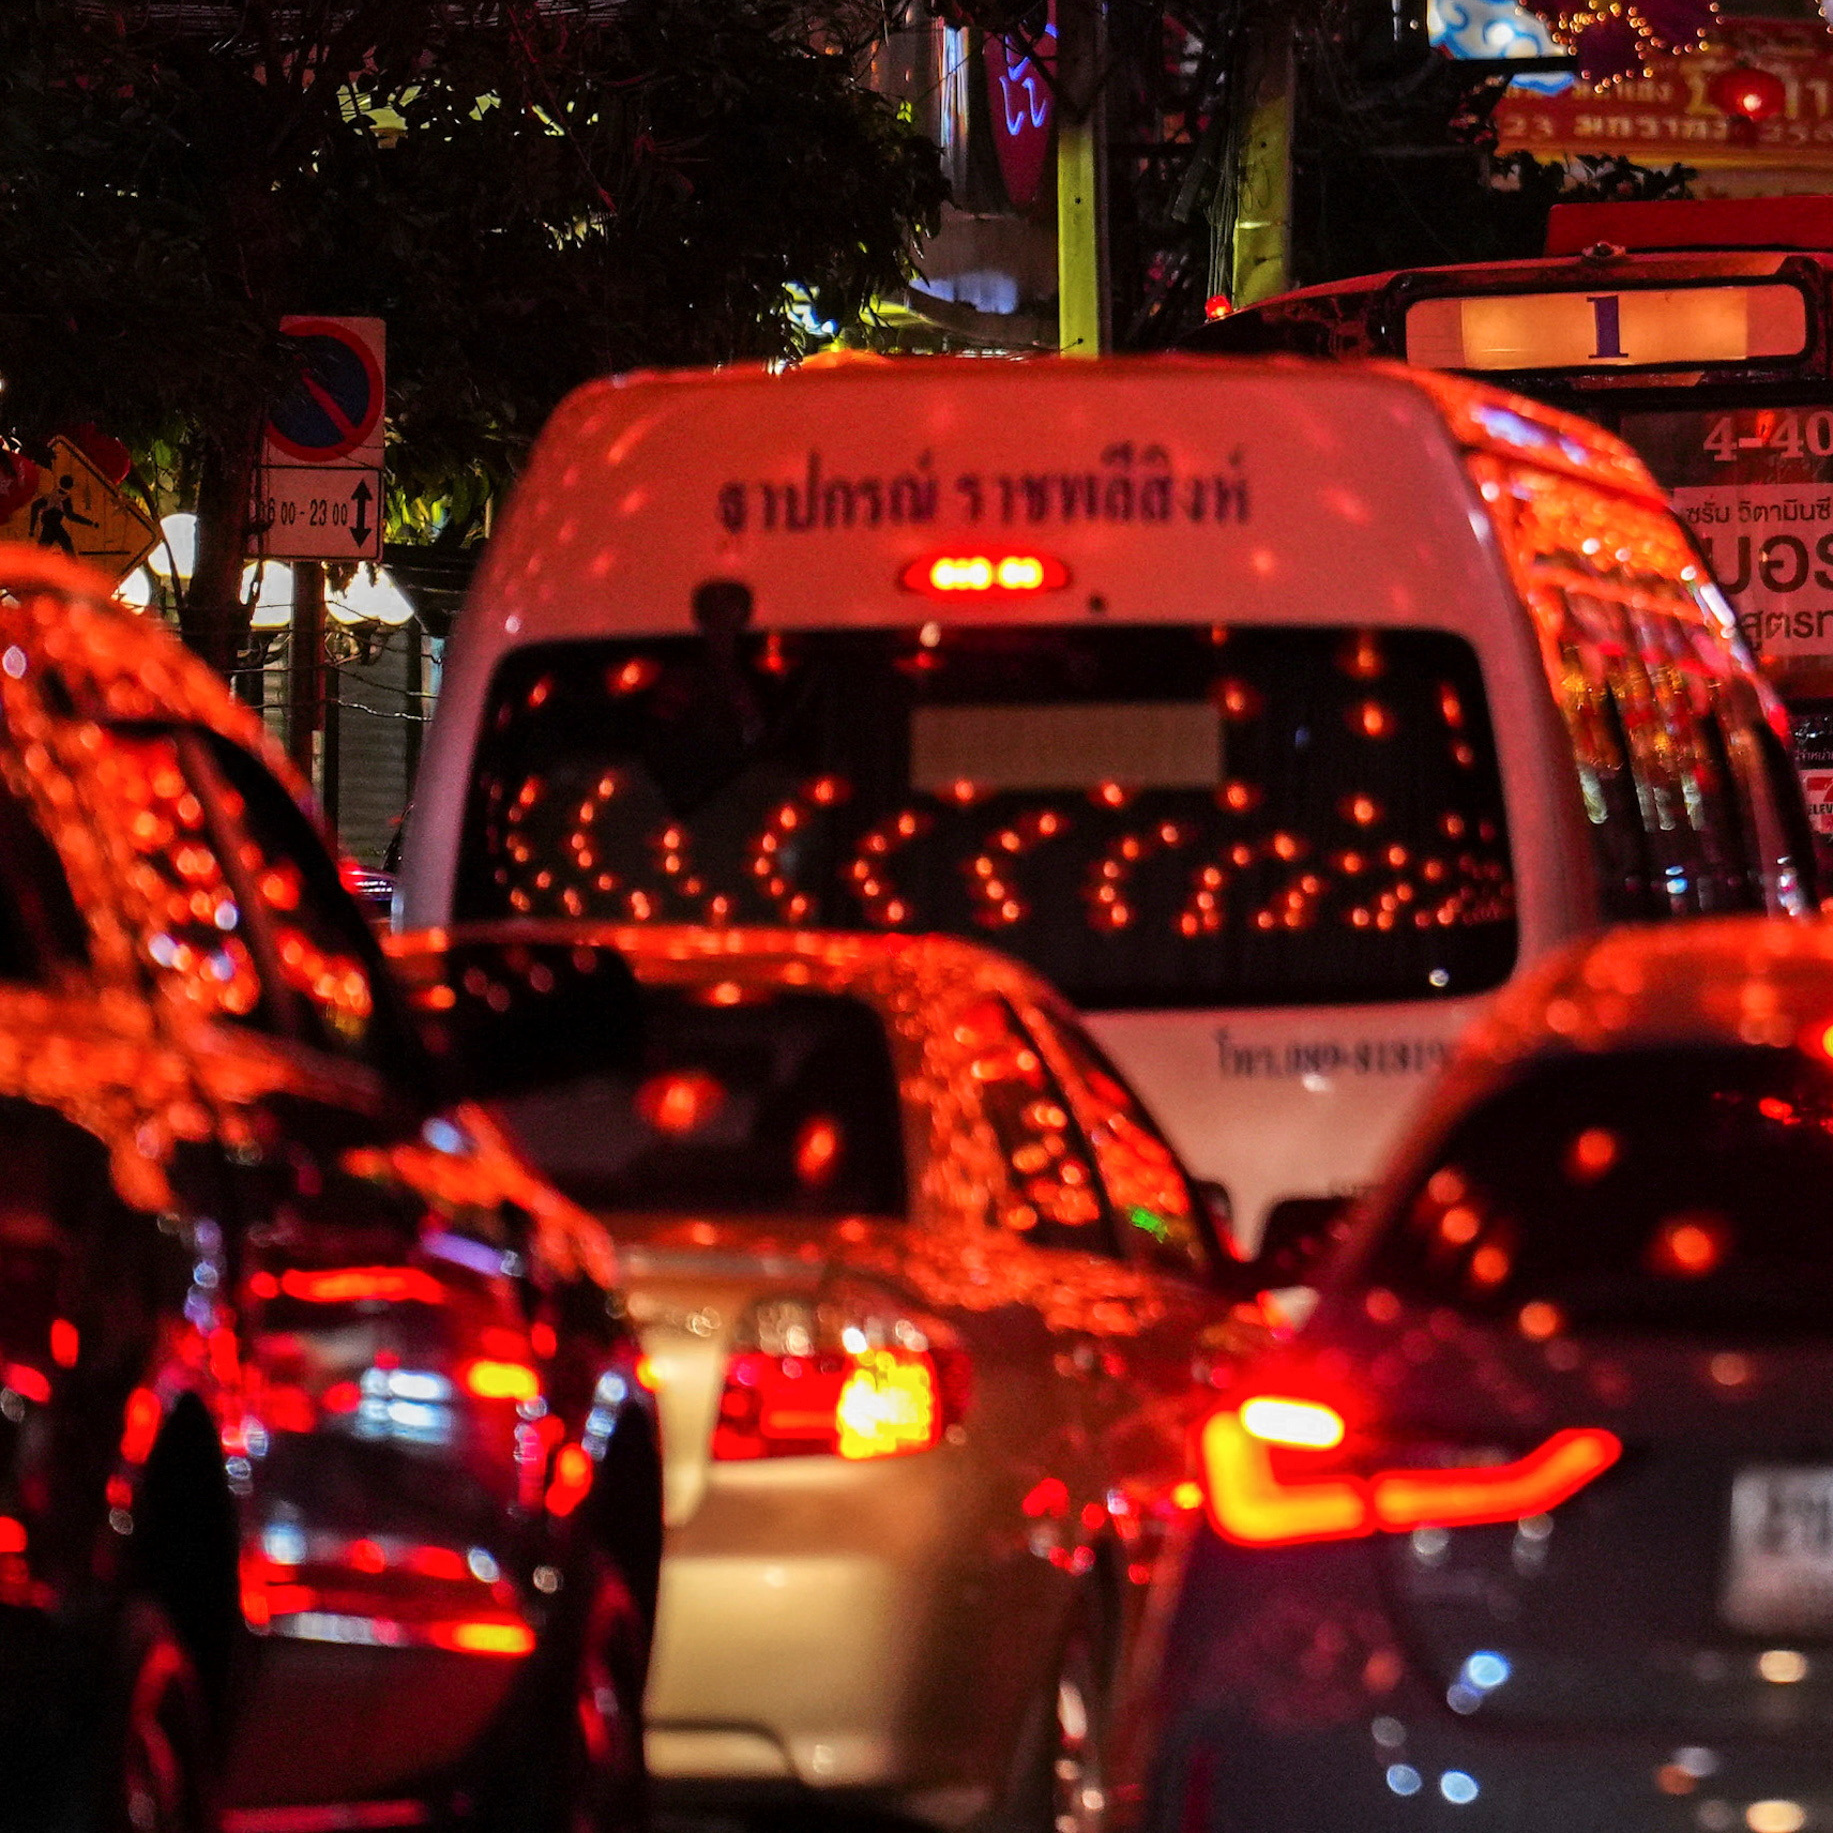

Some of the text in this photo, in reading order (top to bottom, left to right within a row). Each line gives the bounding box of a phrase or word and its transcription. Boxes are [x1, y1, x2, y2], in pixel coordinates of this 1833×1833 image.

[1586, 295, 1629, 359] 1
[1685, 492, 1832, 524] ซรั่ม วิตามินซี
